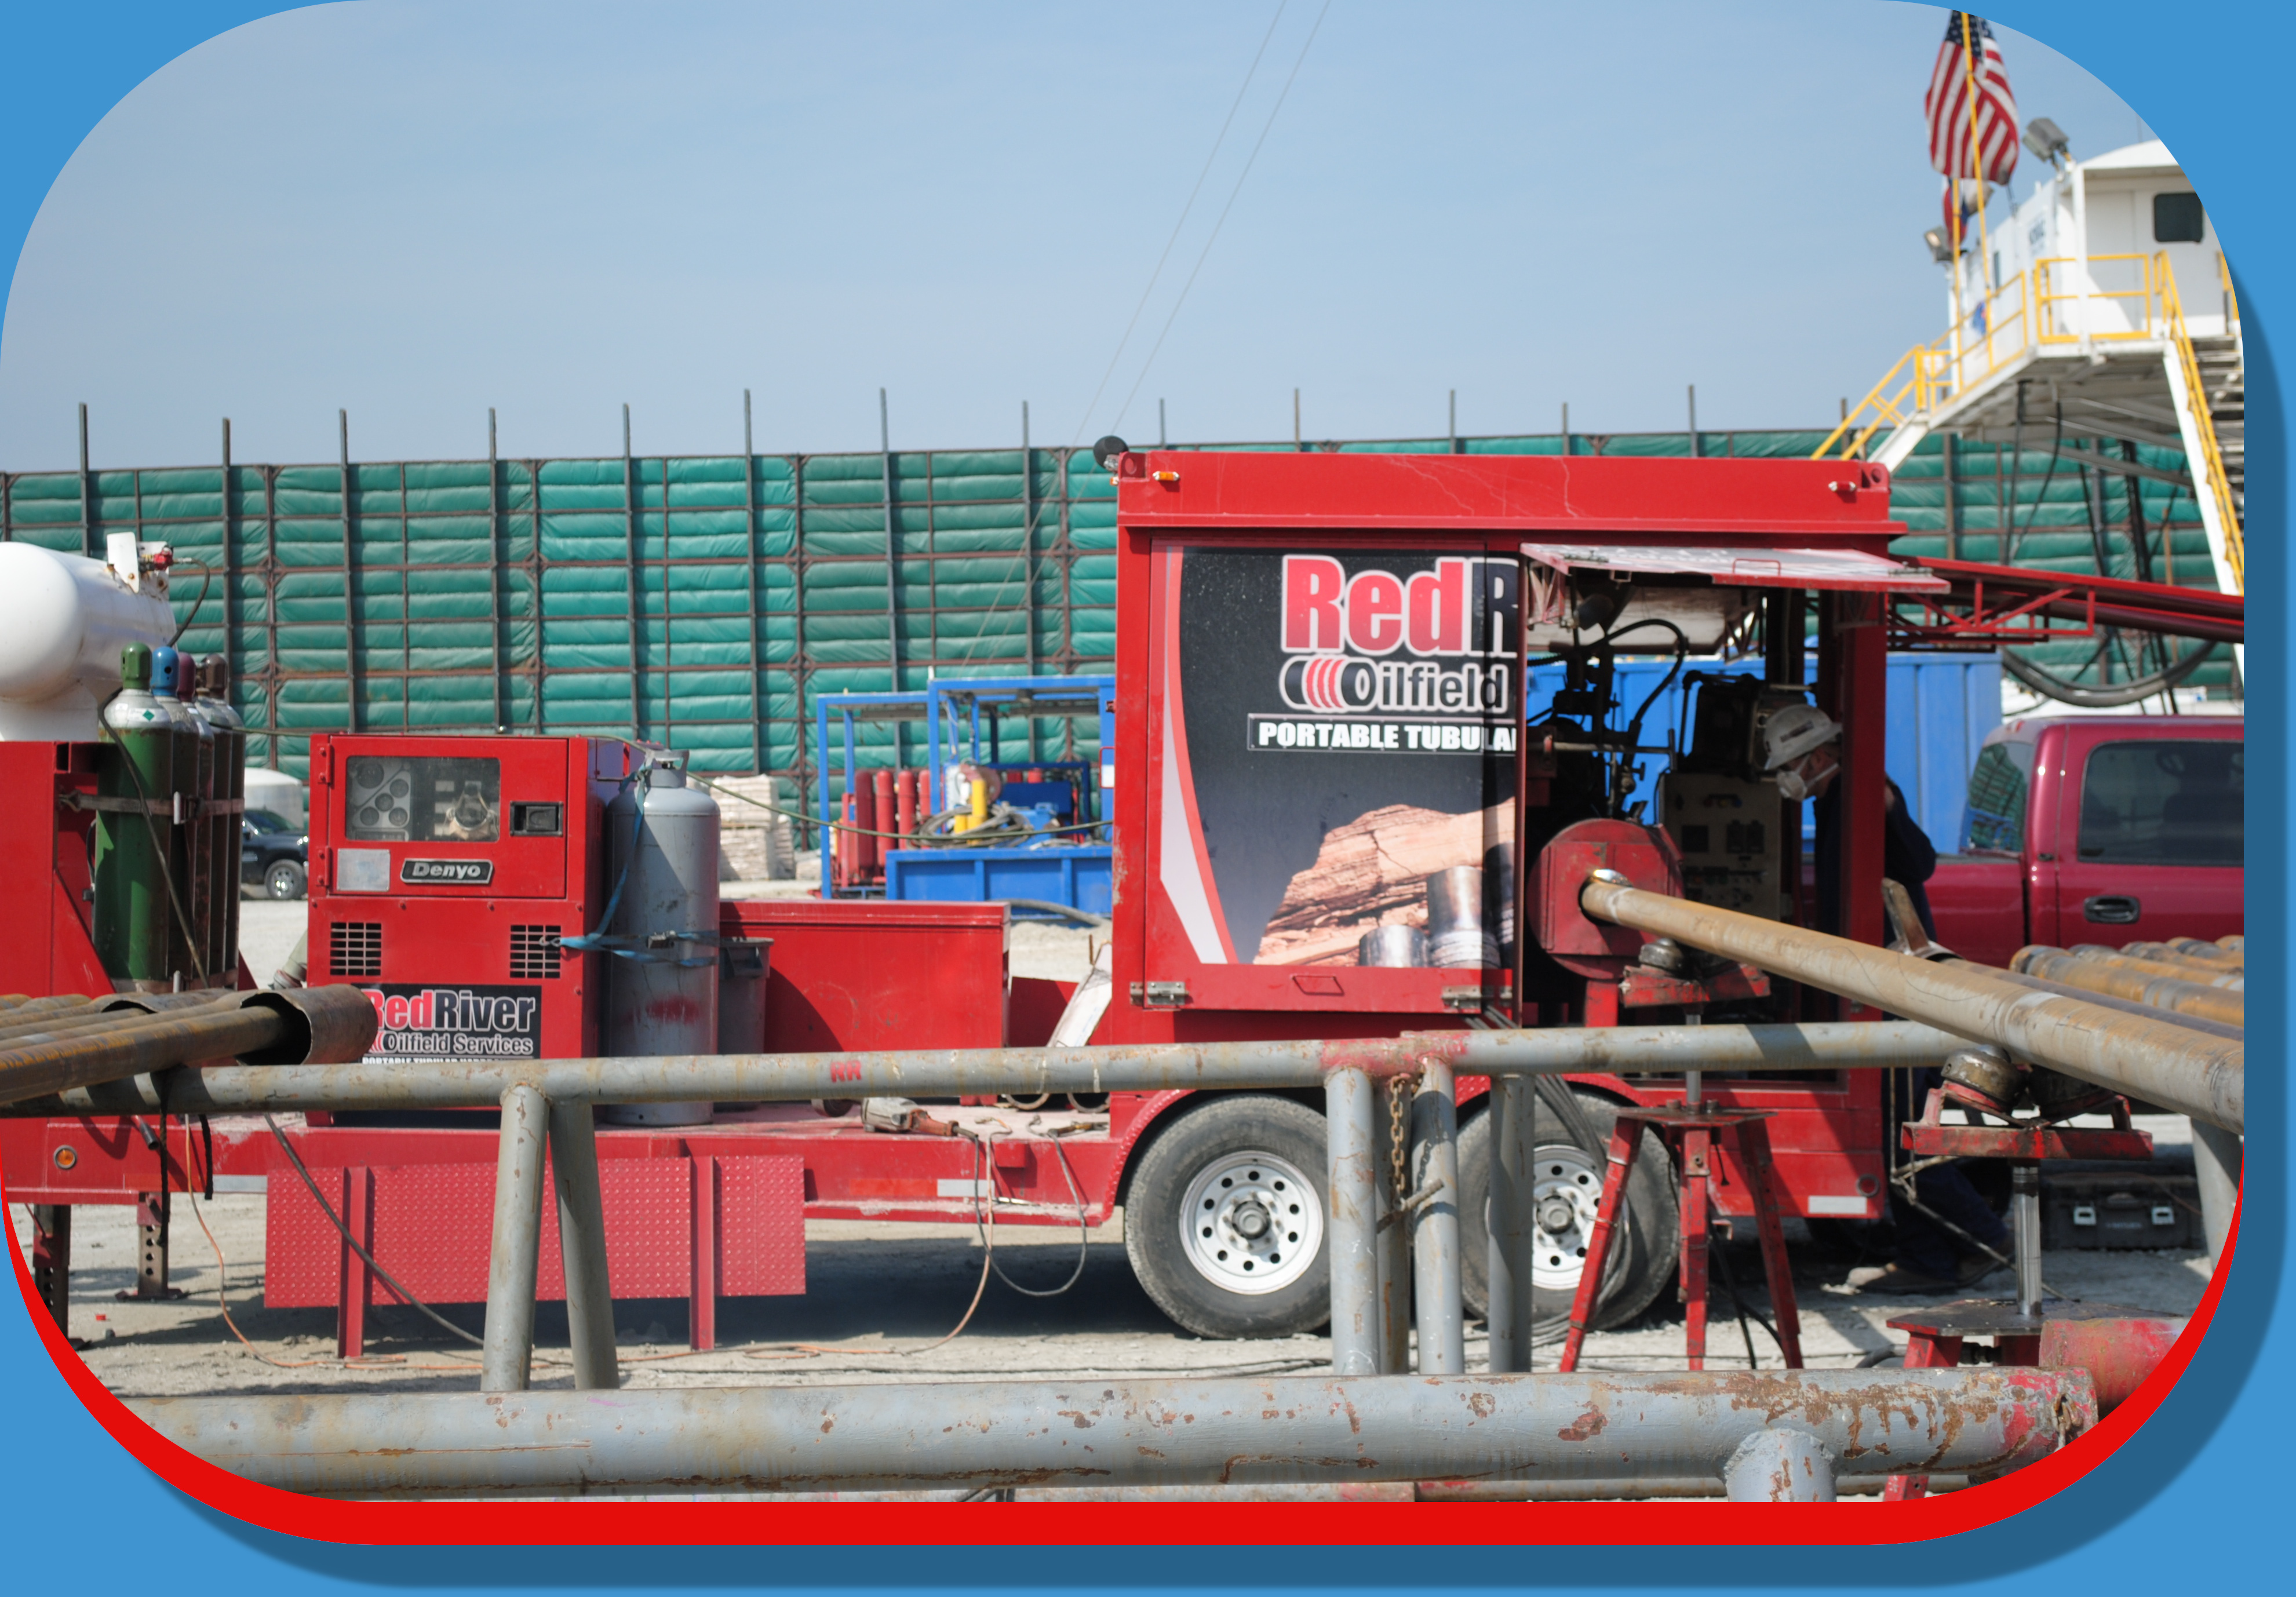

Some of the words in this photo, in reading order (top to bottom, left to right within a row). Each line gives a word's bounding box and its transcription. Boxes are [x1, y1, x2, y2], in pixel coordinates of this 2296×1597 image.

[1335, 657, 1508, 713] Oilfield
[1259, 722, 1398, 748] PORTABLE
[1404, 725, 1517, 752] TUBULA
[412, 862, 481, 879] Denyo
[382, 1031, 450, 1053] Oilfield
[453, 1033, 533, 1055] Services
[830, 1060, 862, 1082] RR
